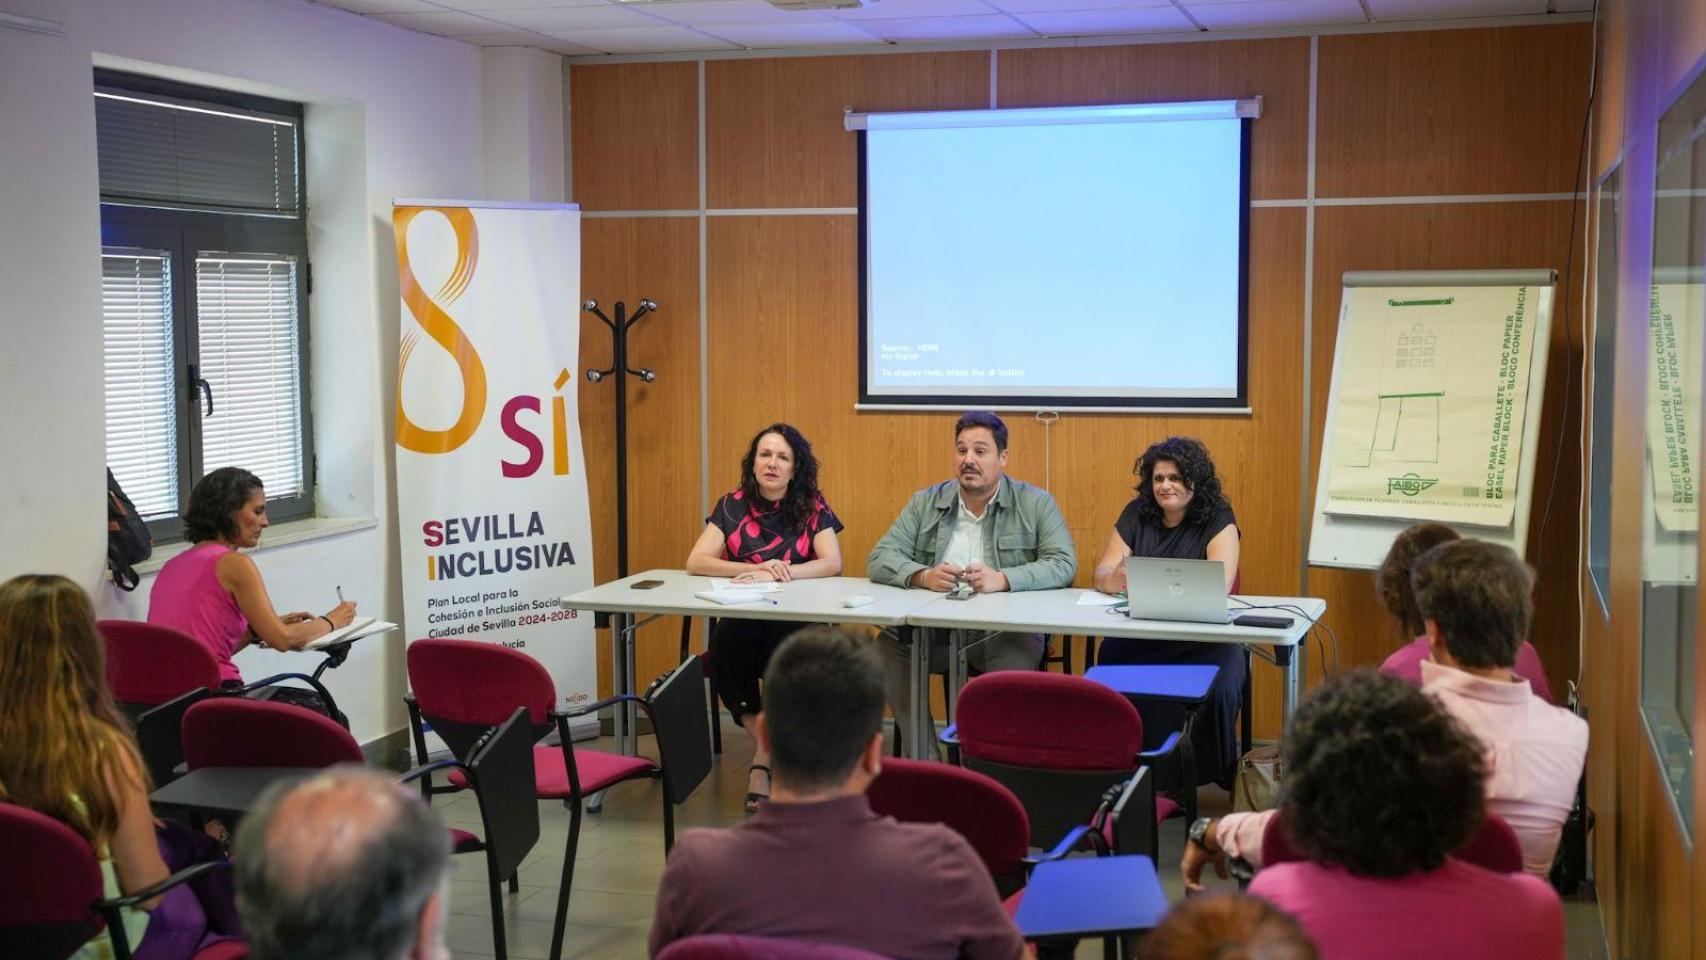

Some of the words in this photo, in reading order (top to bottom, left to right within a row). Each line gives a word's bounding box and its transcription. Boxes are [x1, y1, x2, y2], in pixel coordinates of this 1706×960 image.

[1503, 315, 1514, 349] PAPIER
[895, 352, 919, 361] Signal
[1499, 351, 1510, 378] BLOC
[881, 368, 892, 376] To
[894, 368, 921, 378] display
[946, 369, 969, 378] press
[972, 368, 985, 376] the
[998, 368, 1025, 377] button
[1506, 357, 1519, 390] BLOCO
[1492, 385, 1506, 442] CABALLETE
[1502, 398, 1513, 432] BLOCK
[1489, 444, 1499, 470] PARA
[1498, 434, 1510, 465] PAPER
[1486, 472, 1496, 499] BLOC
[1495, 468, 1506, 499] EASEL
[422, 511, 544, 547] SEVILLA
[427, 541, 576, 581] INCLUSIVA
[428, 597, 450, 609] Plan
[452, 592, 480, 605] Local
[482, 591, 507, 604] para
[508, 588, 519, 598] la
[428, 609, 475, 624] Cohesión
[477, 607, 484, 617] e
[485, 602, 530, 616] Inclusión
[428, 625, 465, 639] Ciudad
[467, 622, 481, 633] de
[482, 618, 516, 631] Sevilla
[518, 609, 578, 626] 2024-2028
